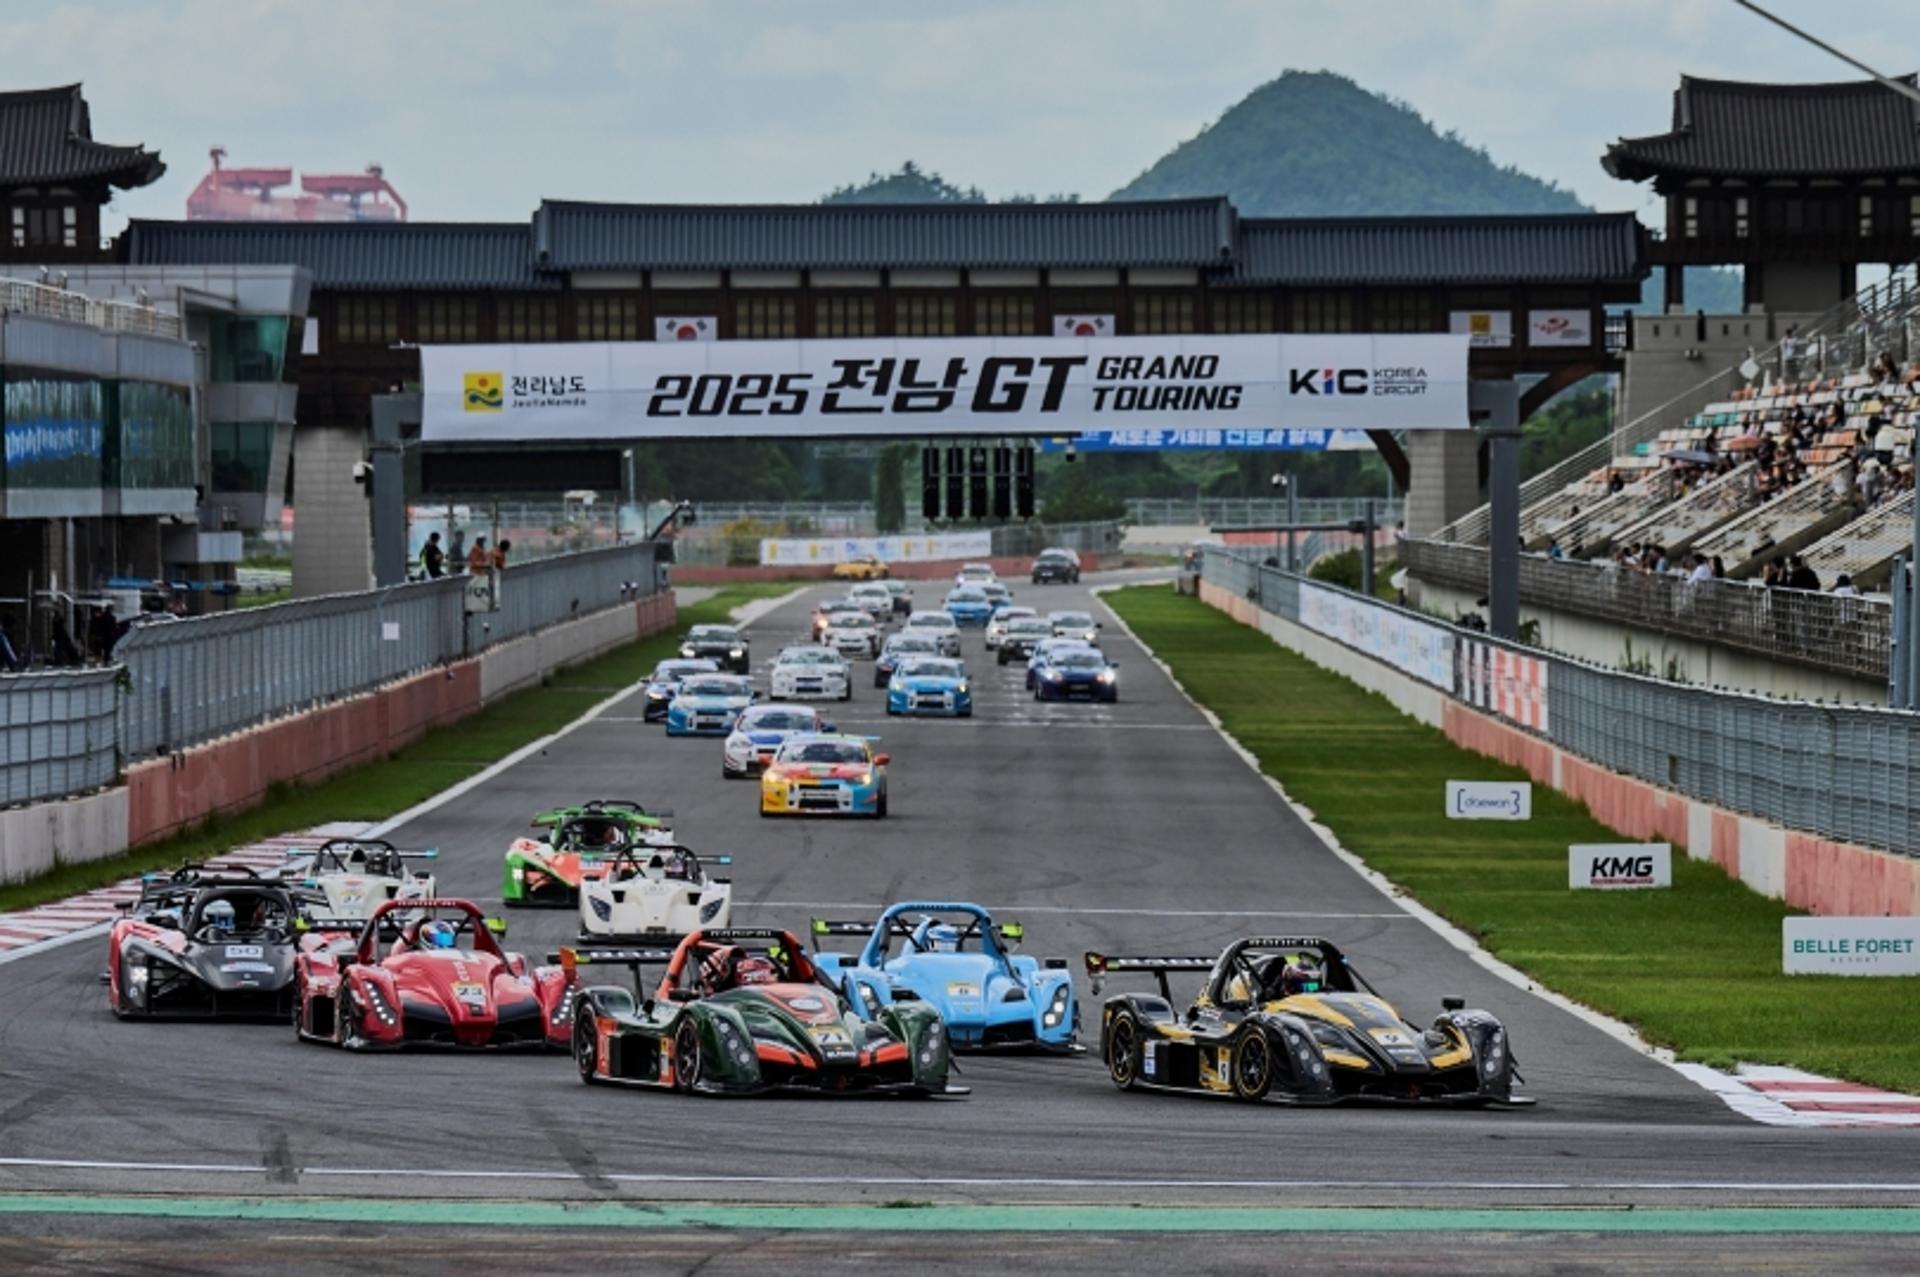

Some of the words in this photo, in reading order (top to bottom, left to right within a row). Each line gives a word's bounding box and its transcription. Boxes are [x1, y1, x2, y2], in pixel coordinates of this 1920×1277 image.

[1096, 355, 1219, 380] GRAND
[1373, 367, 1427, 378] KOREA
[511, 375, 586, 396] 전라남도
[646, 373, 814, 417] 2025
[1374, 385, 1427, 396] CIRCUIT
[1092, 385, 1243, 411] TOURING
[1590, 856, 1654, 877] KMG
[1793, 939, 1850, 954] BELLE
[1855, 939, 1914, 954] FORET
[457, 987, 482, 996] 23
